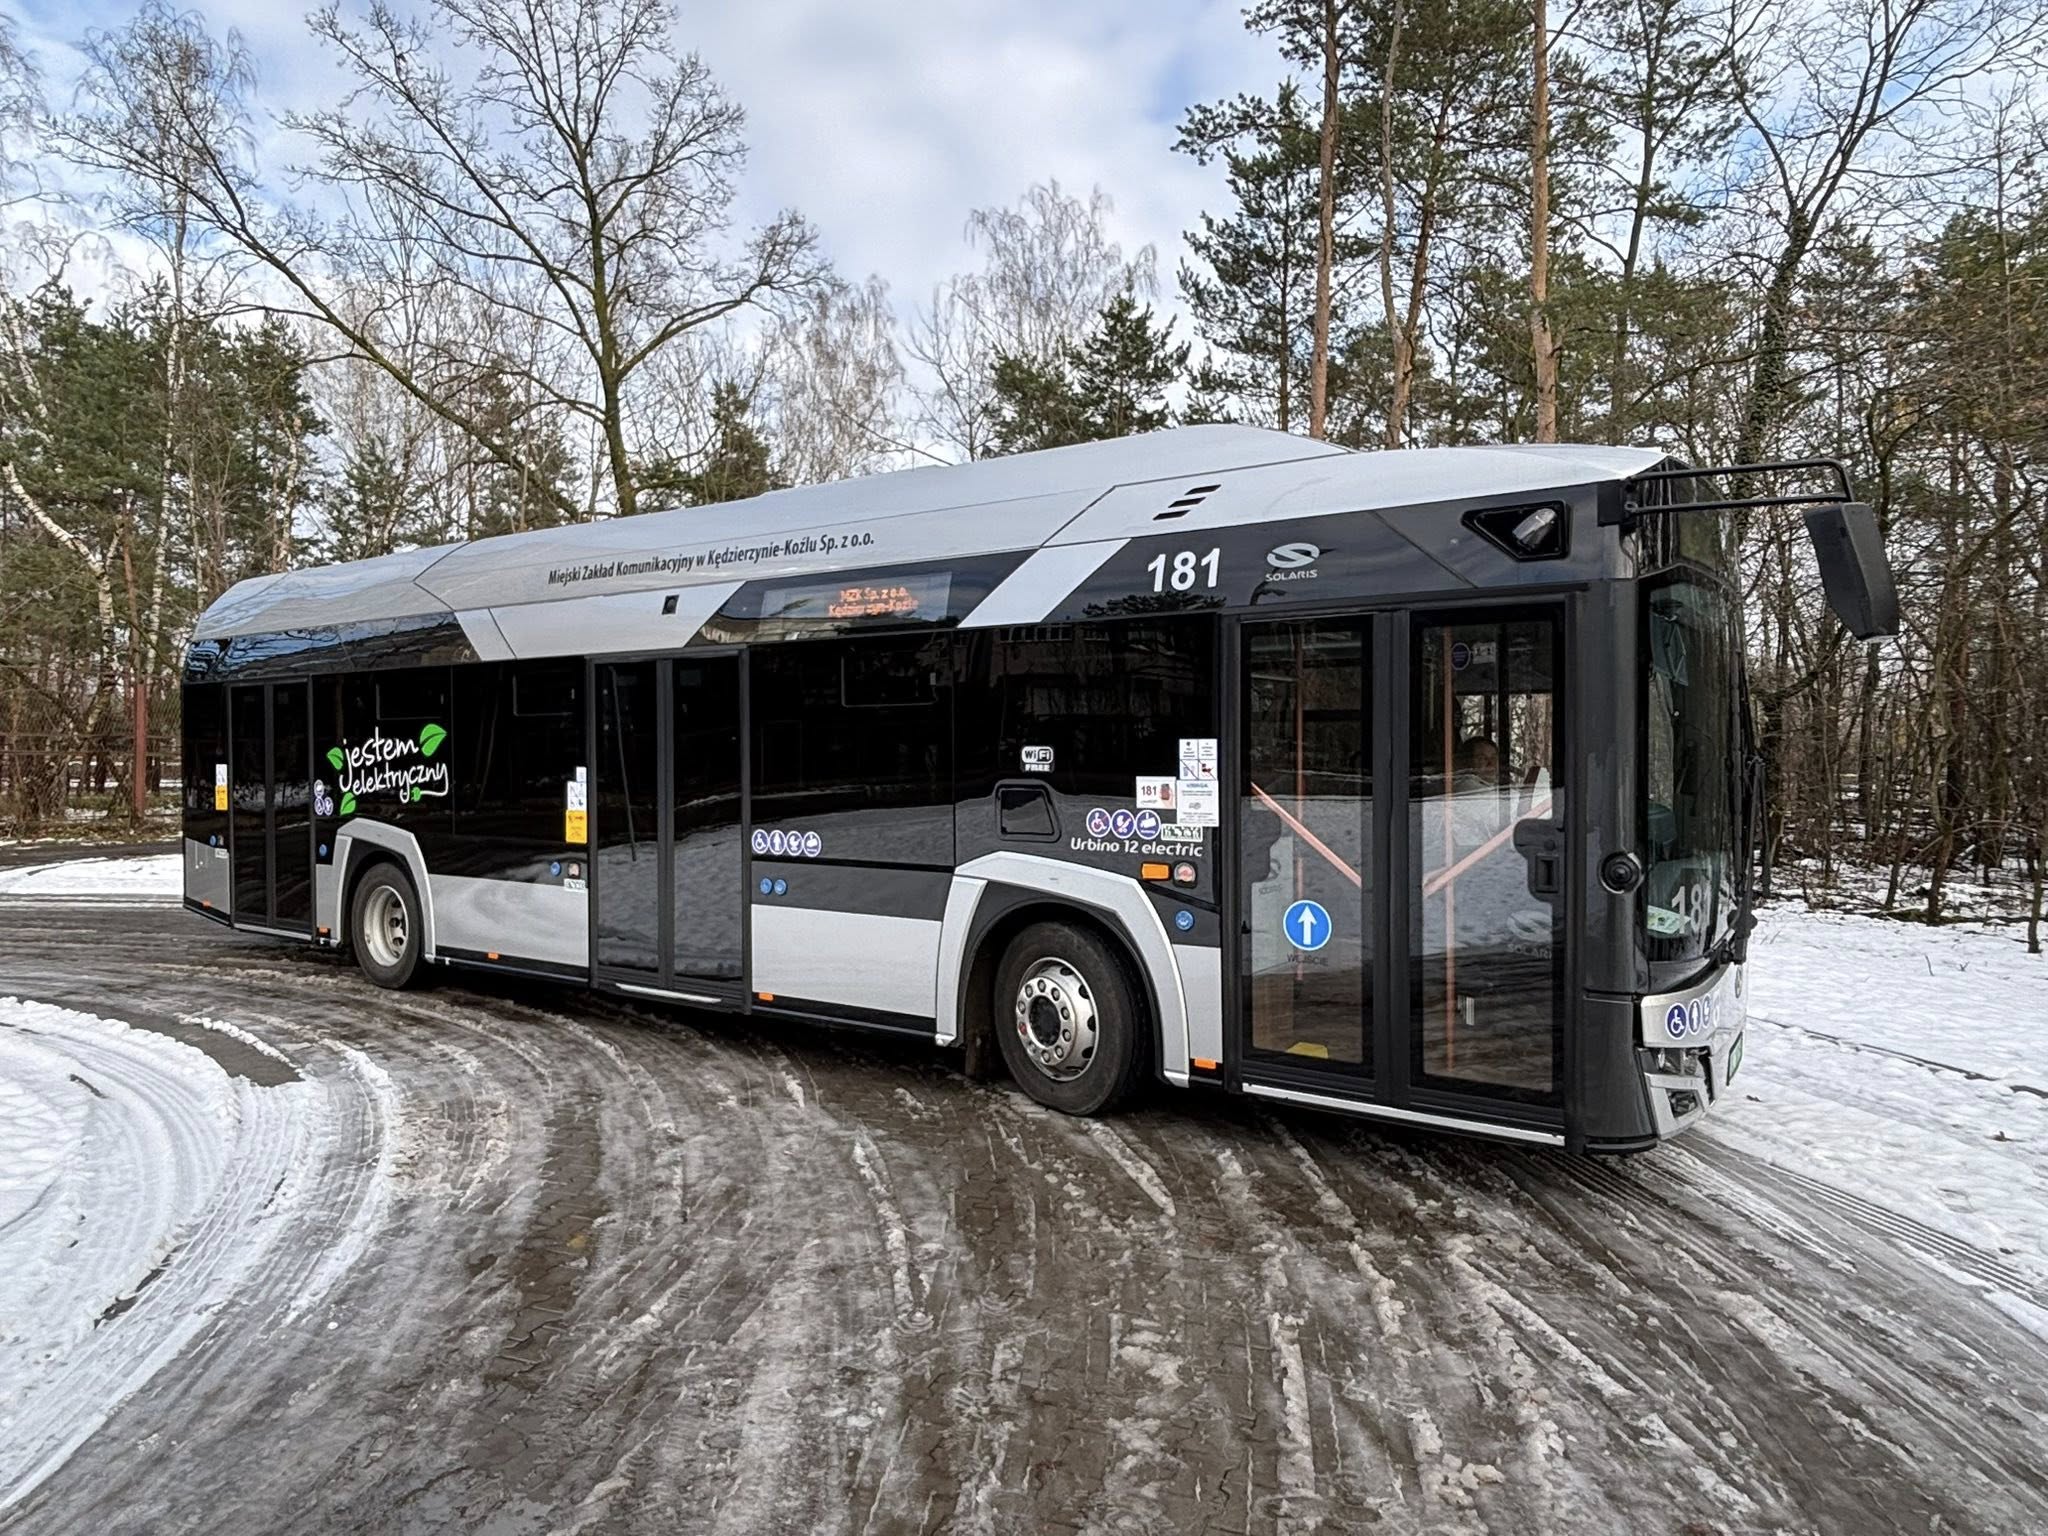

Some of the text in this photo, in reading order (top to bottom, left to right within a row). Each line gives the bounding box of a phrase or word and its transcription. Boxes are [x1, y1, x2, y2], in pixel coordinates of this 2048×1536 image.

[548, 532, 874, 587] Miejski Zakład Komunikacyjny w Kędzierzynie-Koźlu Sp. z o.o.
[1147, 548, 1220, 592] 181
[1265, 569, 1318, 582] SOLARIS
[339, 726, 420, 792] jestem
[352, 762, 449, 803] elektryczny
[1141, 785, 1157, 796] 181
[1070, 837, 1204, 857] Urbino 12 electric
[1671, 884, 1711, 934] 181
